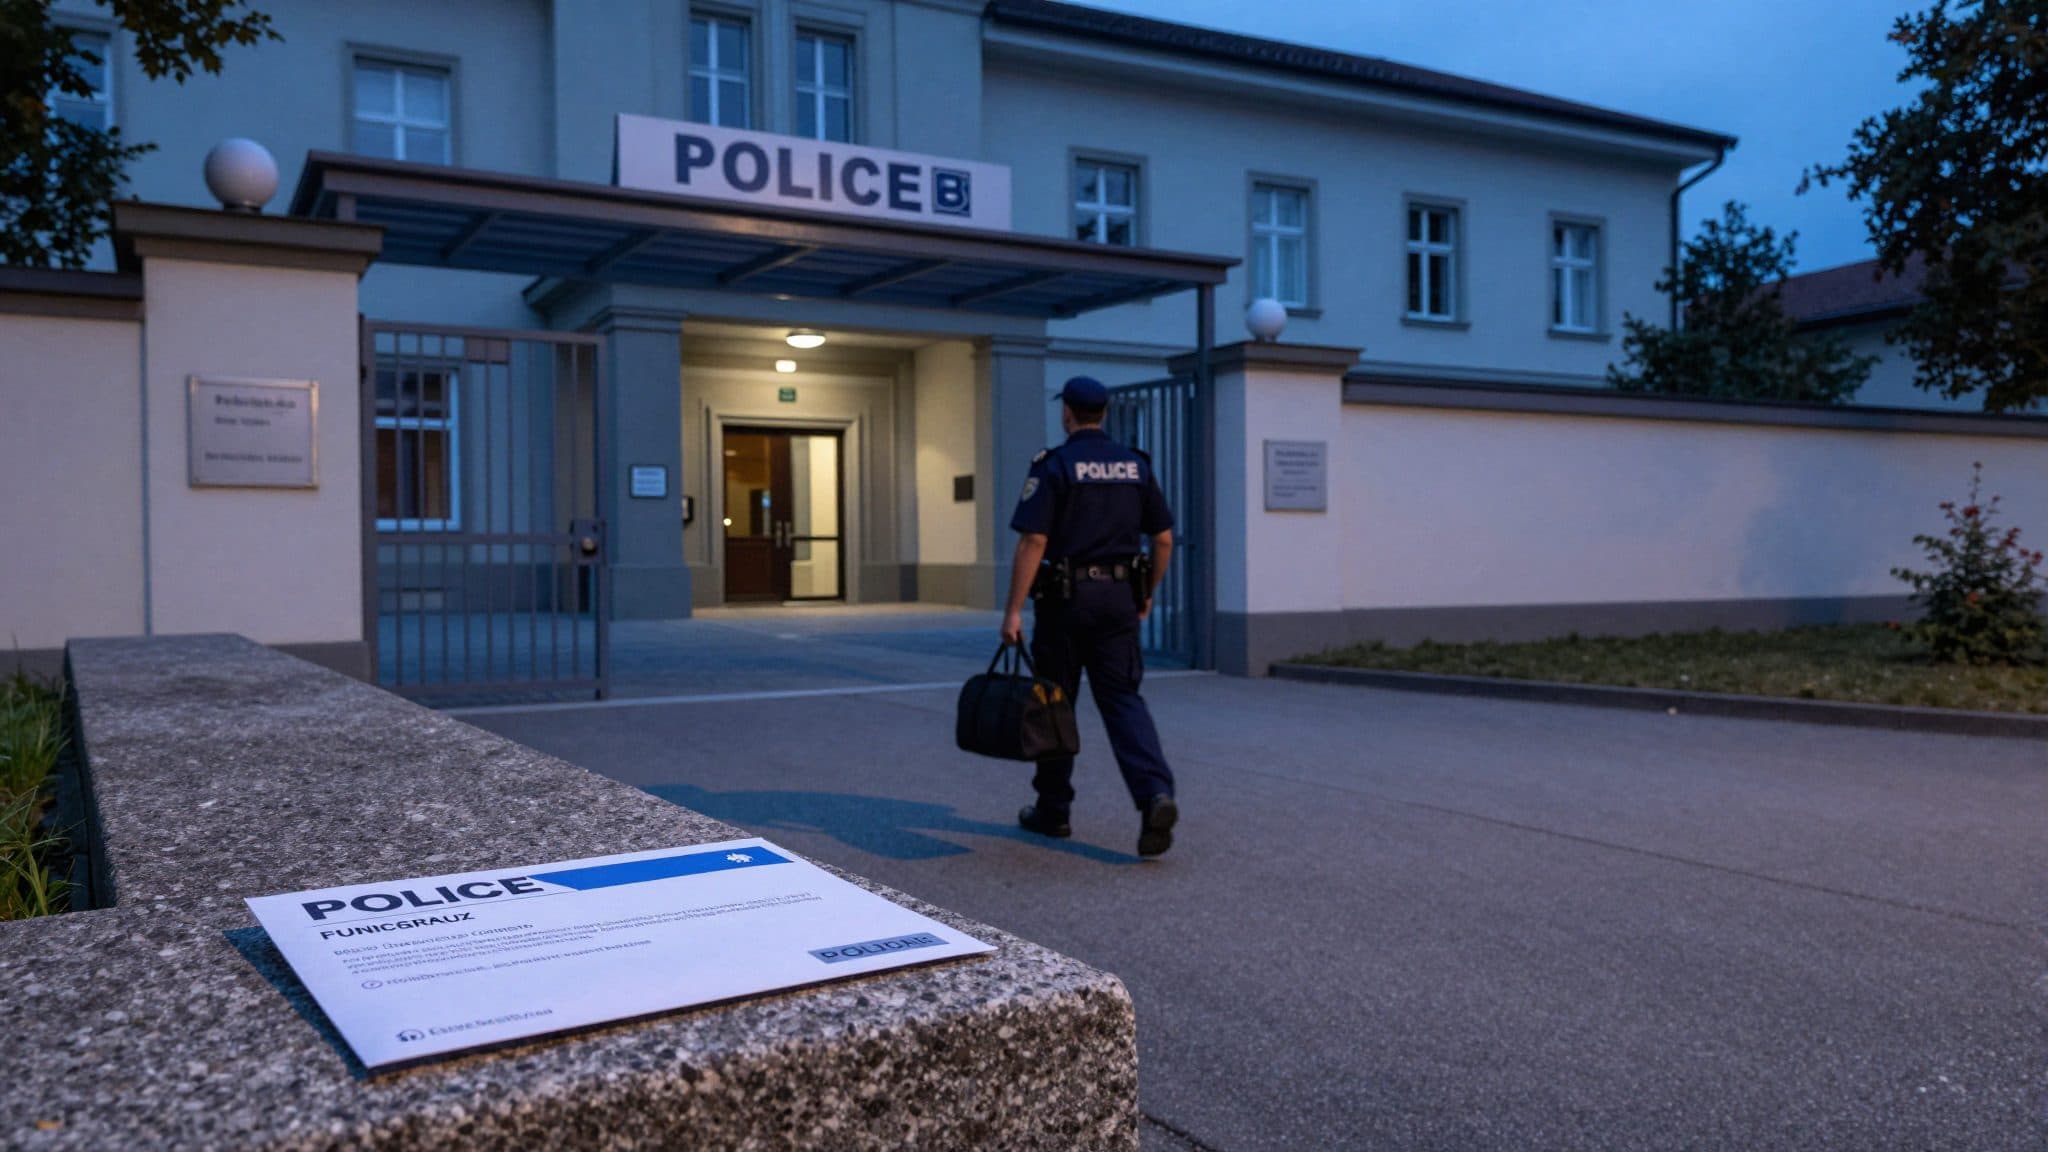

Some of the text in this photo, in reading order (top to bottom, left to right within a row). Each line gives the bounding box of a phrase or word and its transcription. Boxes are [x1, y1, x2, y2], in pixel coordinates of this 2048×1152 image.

[675, 133, 922, 213] POLICE
[1075, 461, 1140, 480] POLICE
[301, 876, 545, 921] POLICE
